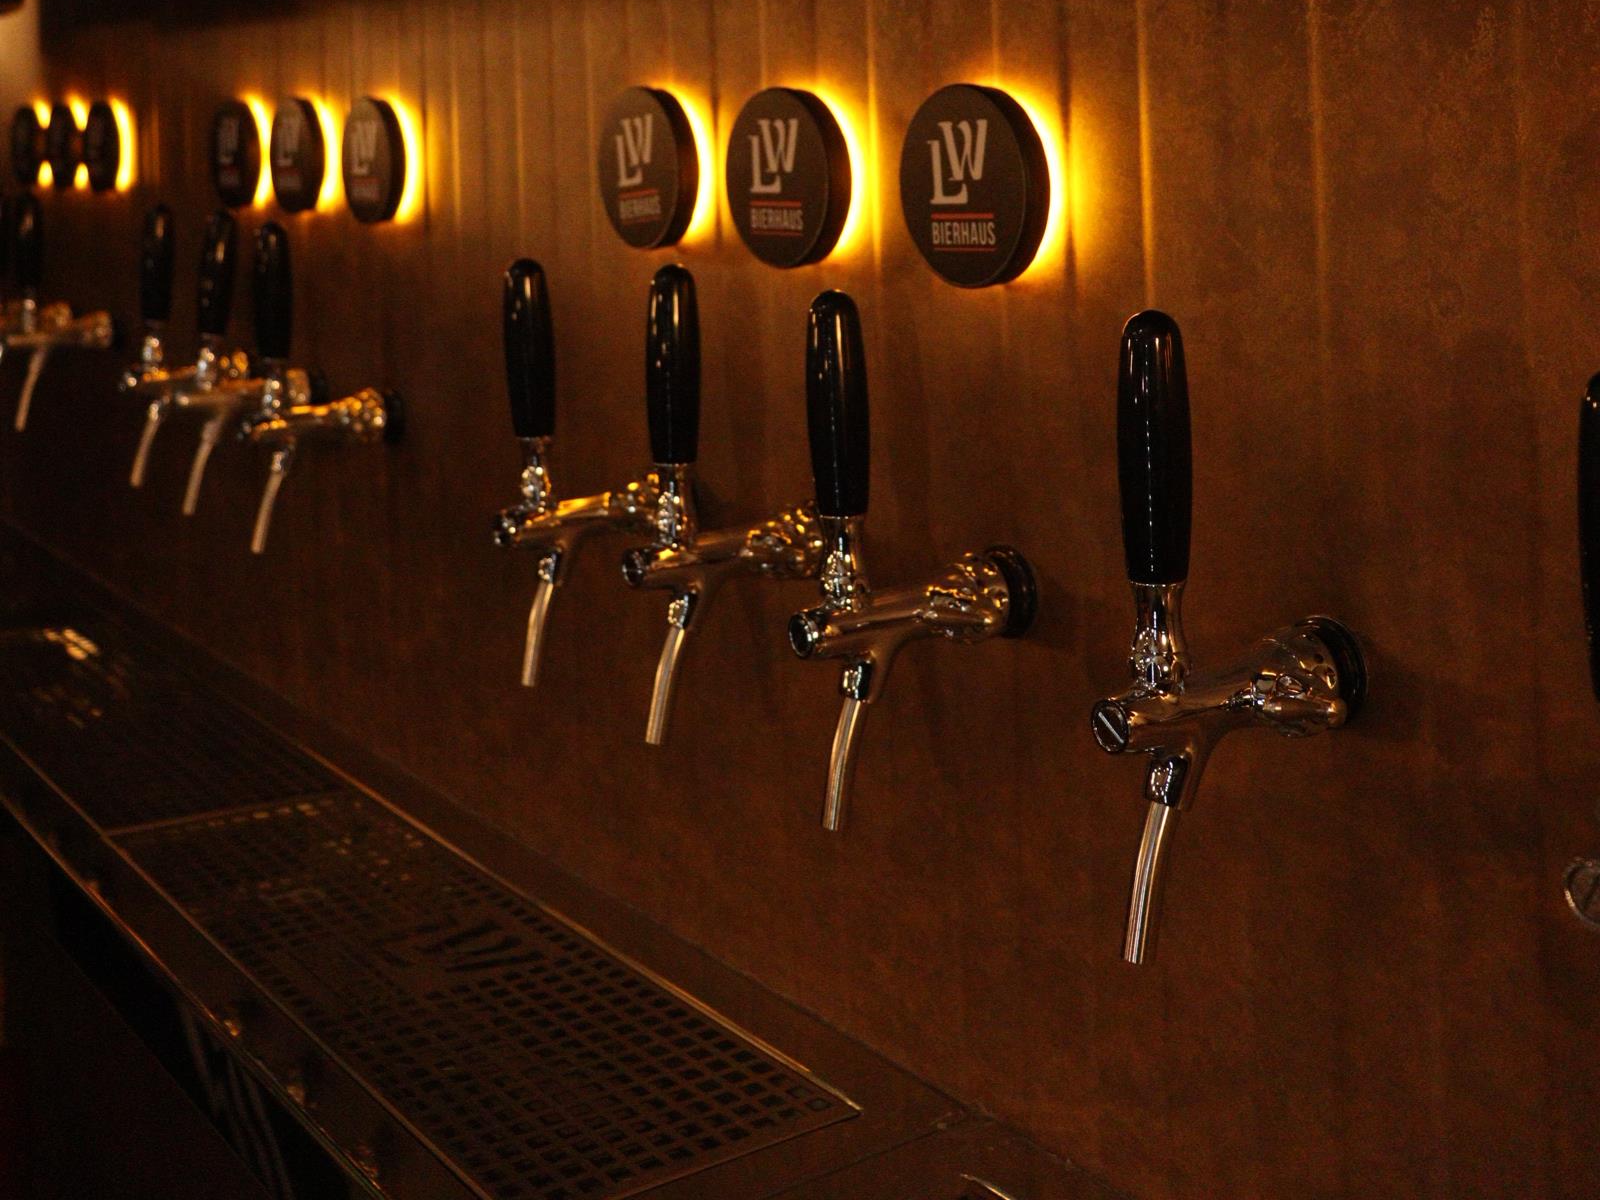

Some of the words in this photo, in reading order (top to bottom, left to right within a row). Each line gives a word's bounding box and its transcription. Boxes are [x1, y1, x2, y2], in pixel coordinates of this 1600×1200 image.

[616, 113, 653, 188] LW
[747, 118, 798, 194] LW
[927, 119, 988, 205] LW
[931, 222, 996, 245] BIERHAUS
